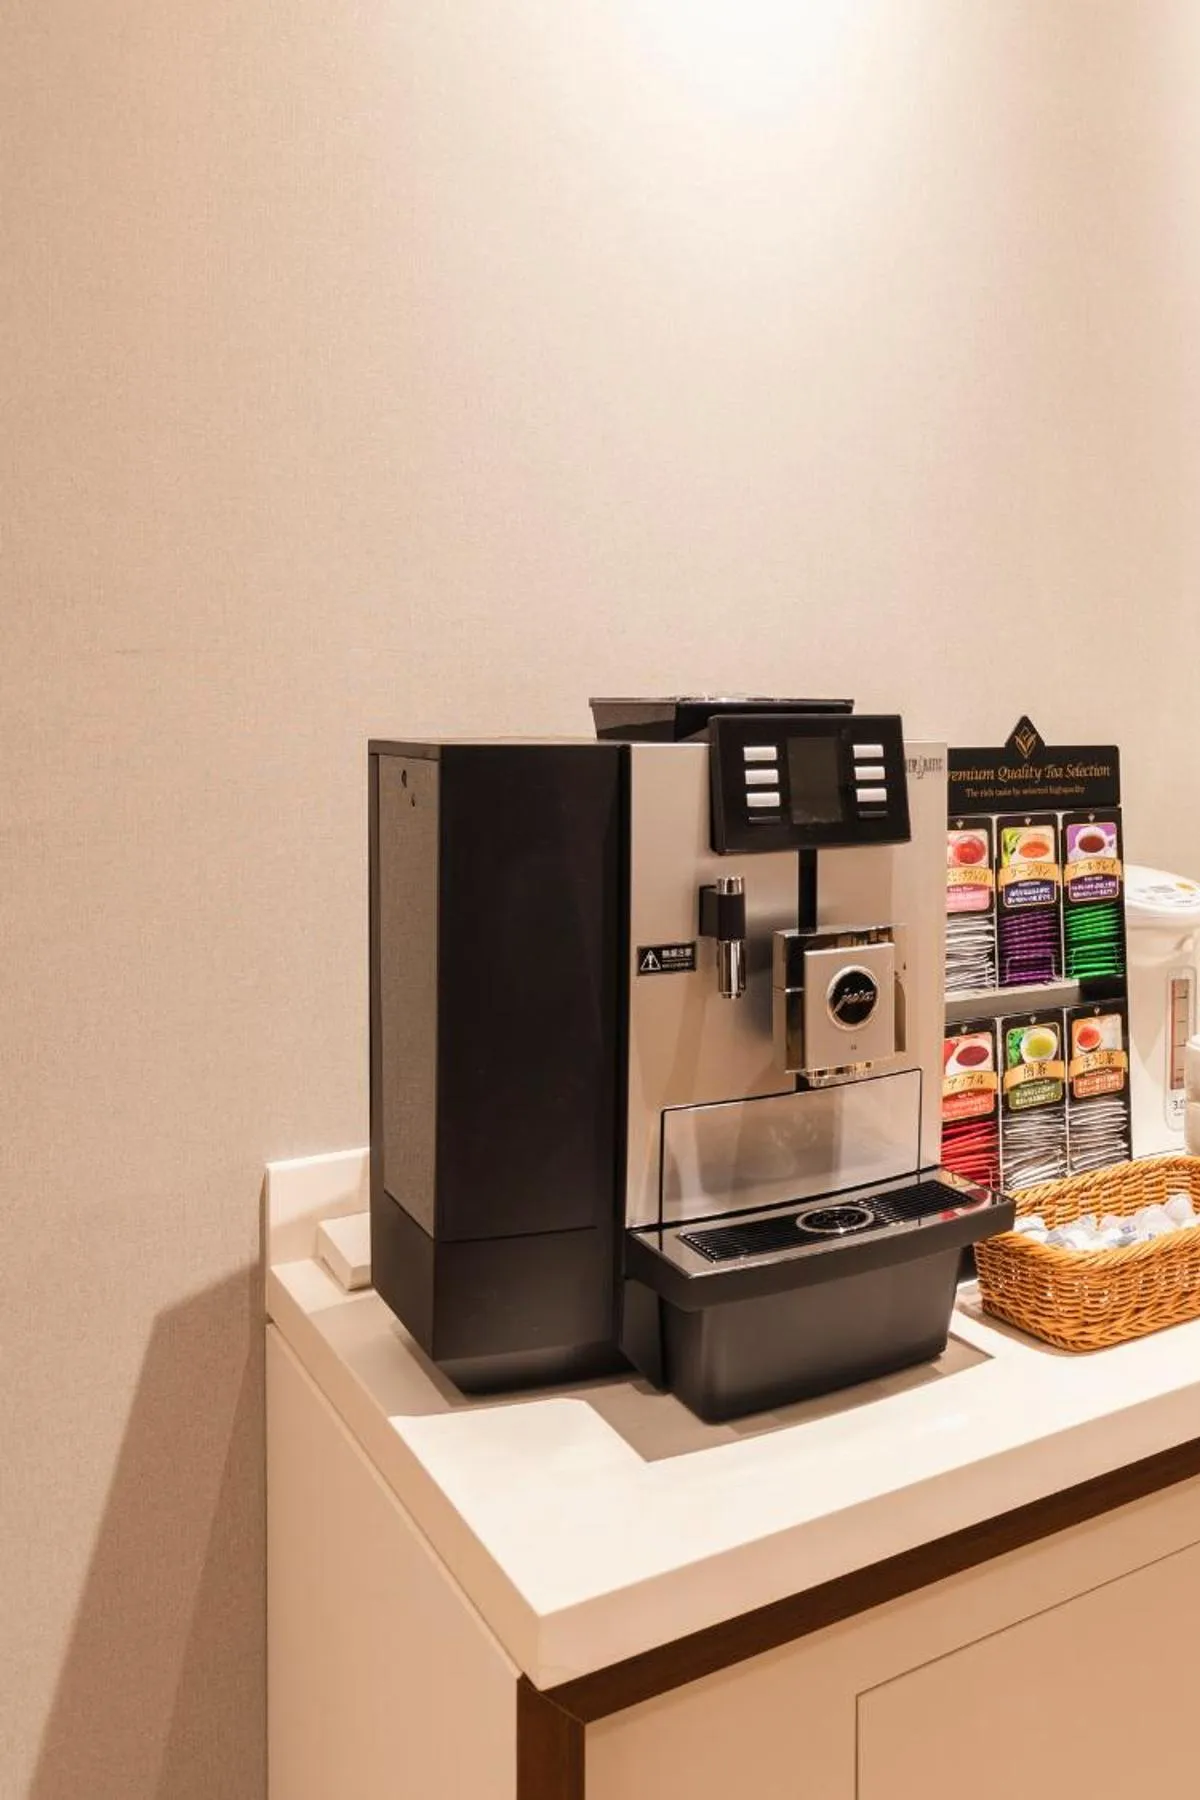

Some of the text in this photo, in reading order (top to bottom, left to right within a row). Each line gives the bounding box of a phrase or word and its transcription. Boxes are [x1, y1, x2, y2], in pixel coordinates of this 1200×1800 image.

[947, 766, 995, 781] remium
[998, 763, 1043, 783] Quality
[1065, 762, 1111, 779] Selection
